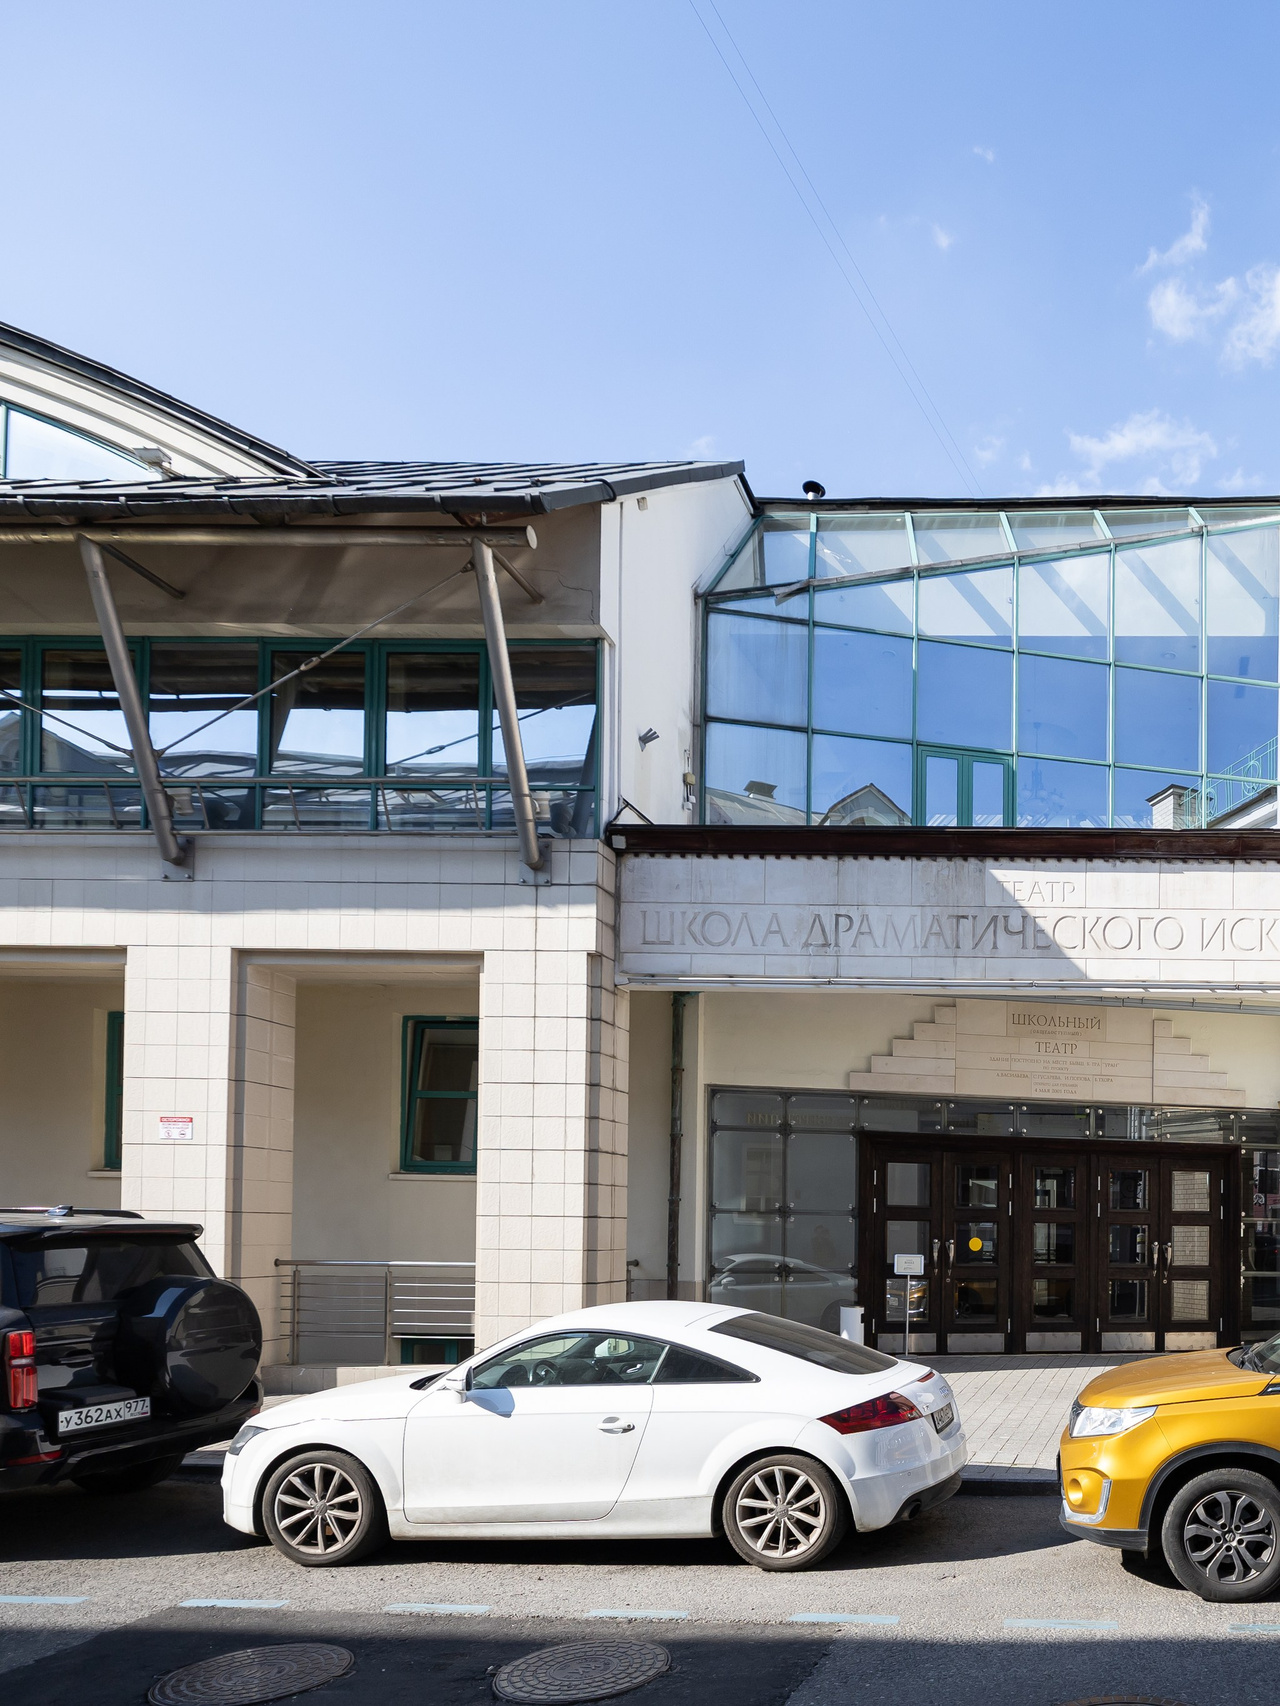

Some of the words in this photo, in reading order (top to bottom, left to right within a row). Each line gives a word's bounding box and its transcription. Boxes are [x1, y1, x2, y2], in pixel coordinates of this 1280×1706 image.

[998, 880, 1076, 903] ТЕАТР
[639, 910, 791, 947] ШКОЛА
[800, 912, 1185, 951] ДРАМАТИЧЕСКОГО
[1011, 1013, 1101, 1030] ШКОЛЬНЫЙ
[1035, 1041, 1078, 1055] ТЕАТР
[64, 1406, 123, 1428] У362АХ
[125, 1399, 146, 1413] 977
